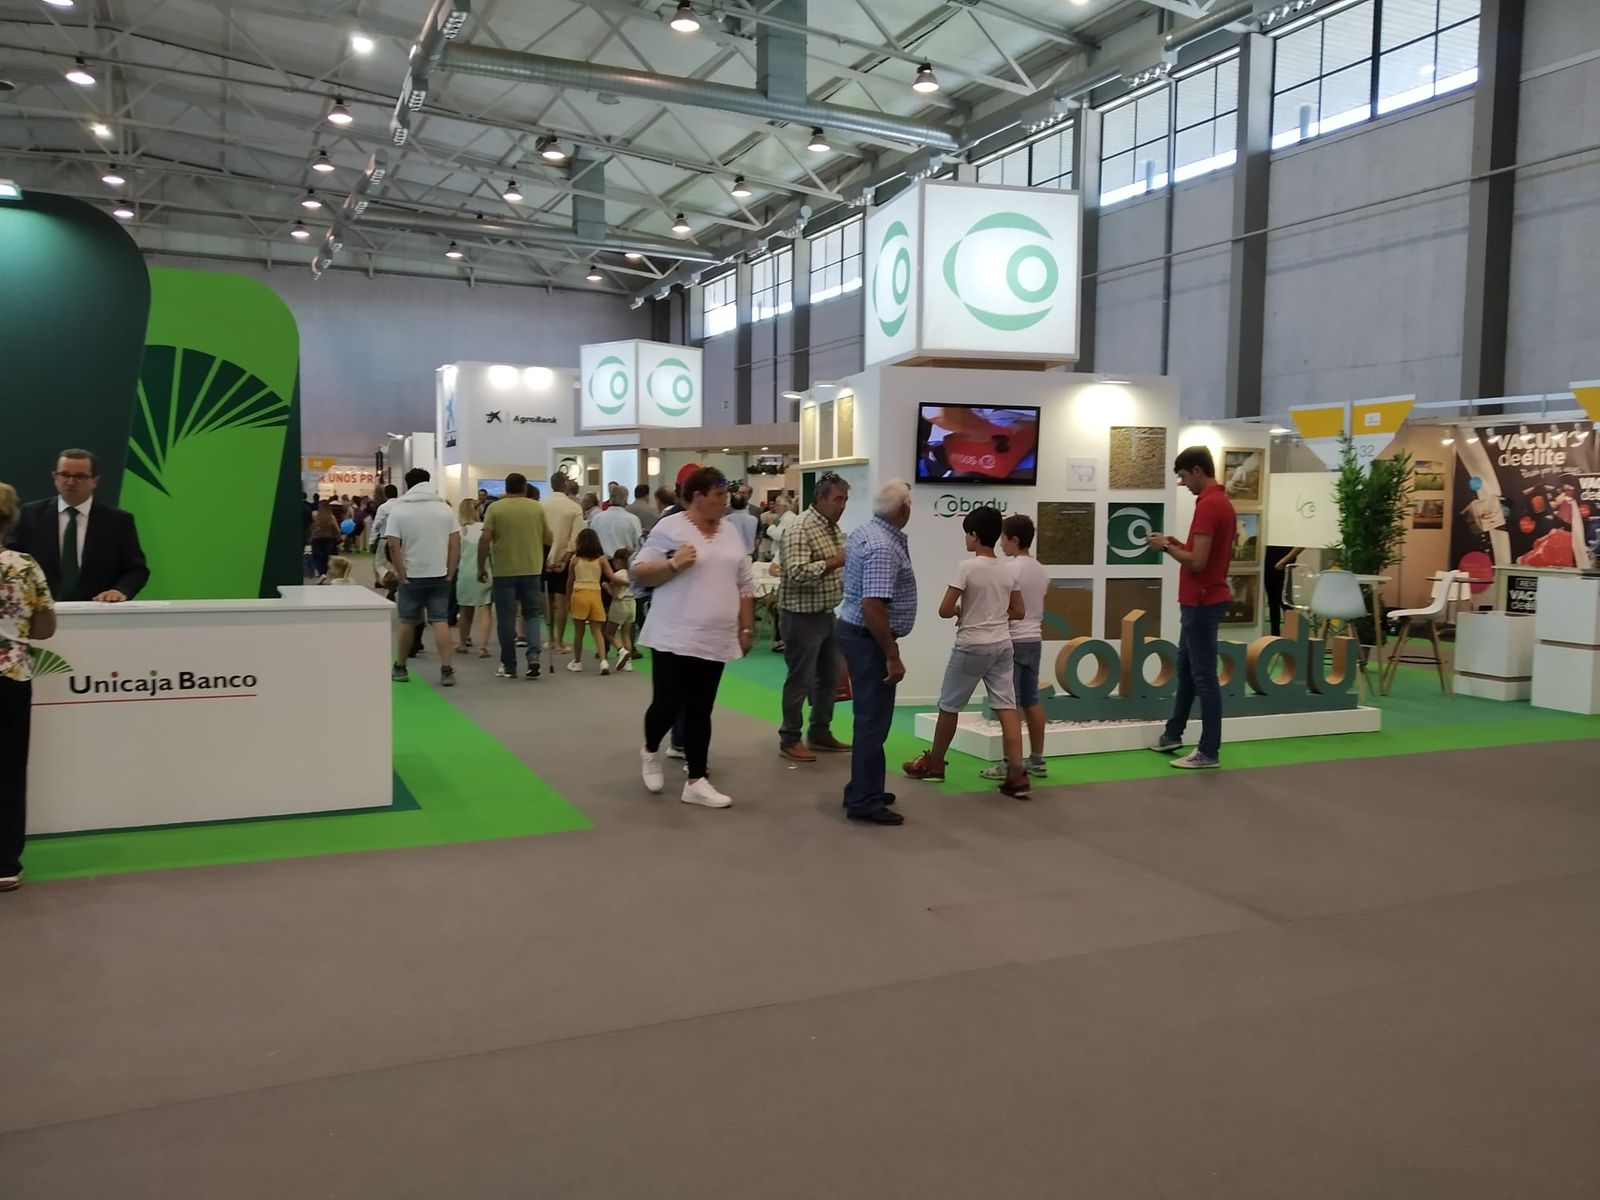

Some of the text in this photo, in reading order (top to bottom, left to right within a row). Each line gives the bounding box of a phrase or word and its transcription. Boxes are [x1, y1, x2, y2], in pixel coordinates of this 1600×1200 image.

[513, 415, 558, 425] AgroBank
[328, 473, 357, 484] UNOS
[69, 670, 257, 697] Unicaja Banco
